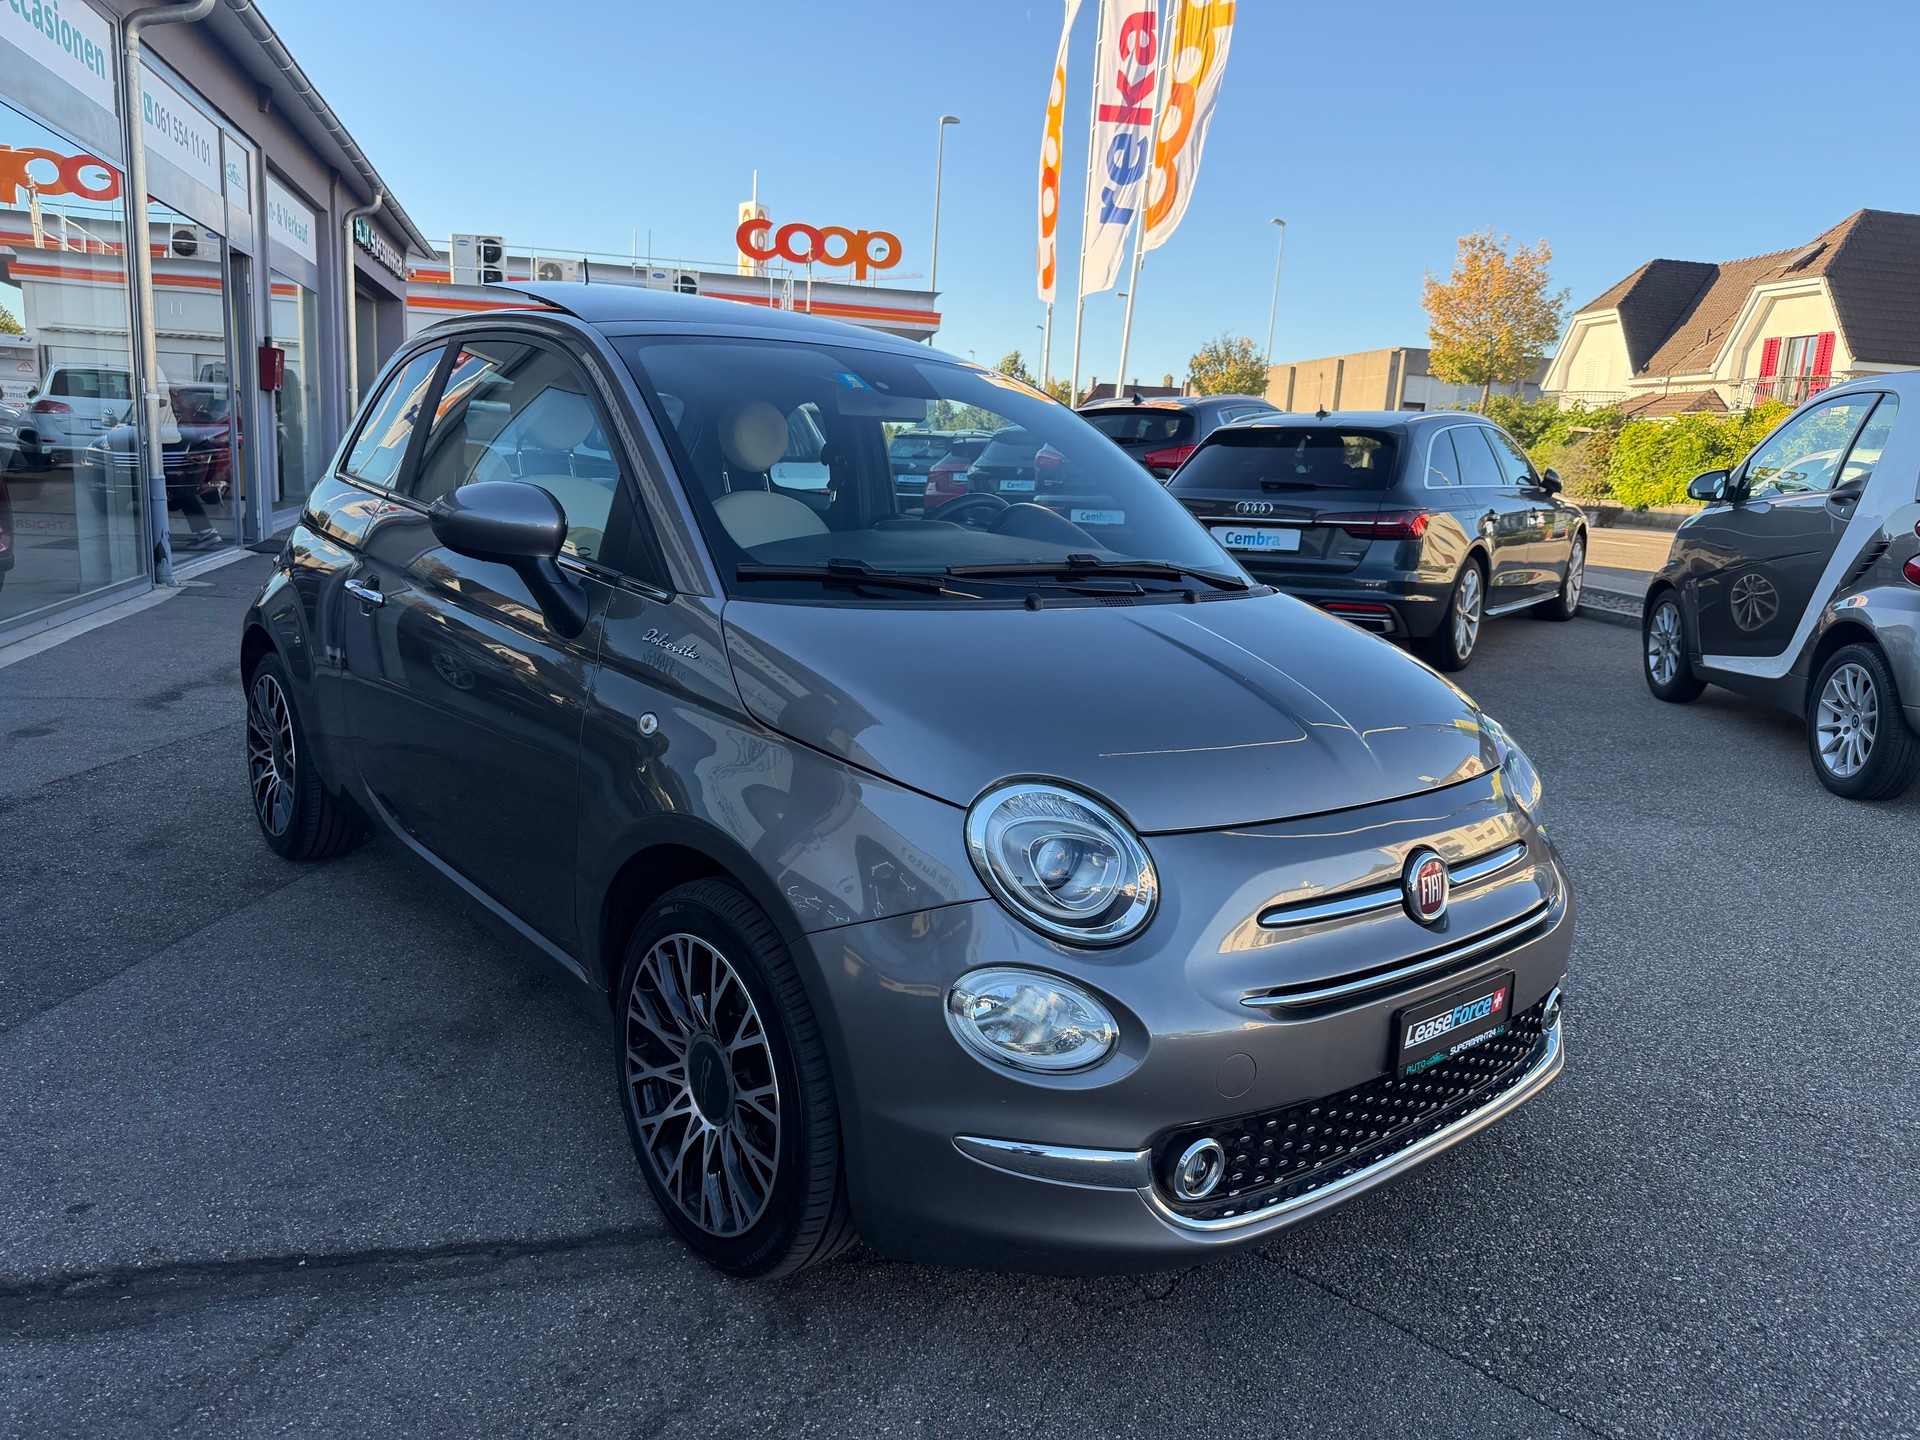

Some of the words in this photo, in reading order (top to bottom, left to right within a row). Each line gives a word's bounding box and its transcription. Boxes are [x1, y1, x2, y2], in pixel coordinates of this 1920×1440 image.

[154, 102, 171, 138] 061
[173, 116, 189, 151] 554
[190, 131, 200, 159] 11
[201, 139, 211, 167] 01
[1097, 11, 1156, 226] reka
[276, 202, 284, 227] &
[283, 207, 309, 246] Verkauf
[736, 218, 903, 280] coop
[1080, 512, 1114, 522] Cembra
[1225, 531, 1281, 547] Cembra
[642, 628, 700, 659] Dolcevita
[1421, 872, 1443, 905] FIAT
[1404, 997, 1493, 1047] LeaseForce
[1406, 1060, 1427, 1075] AUTO
